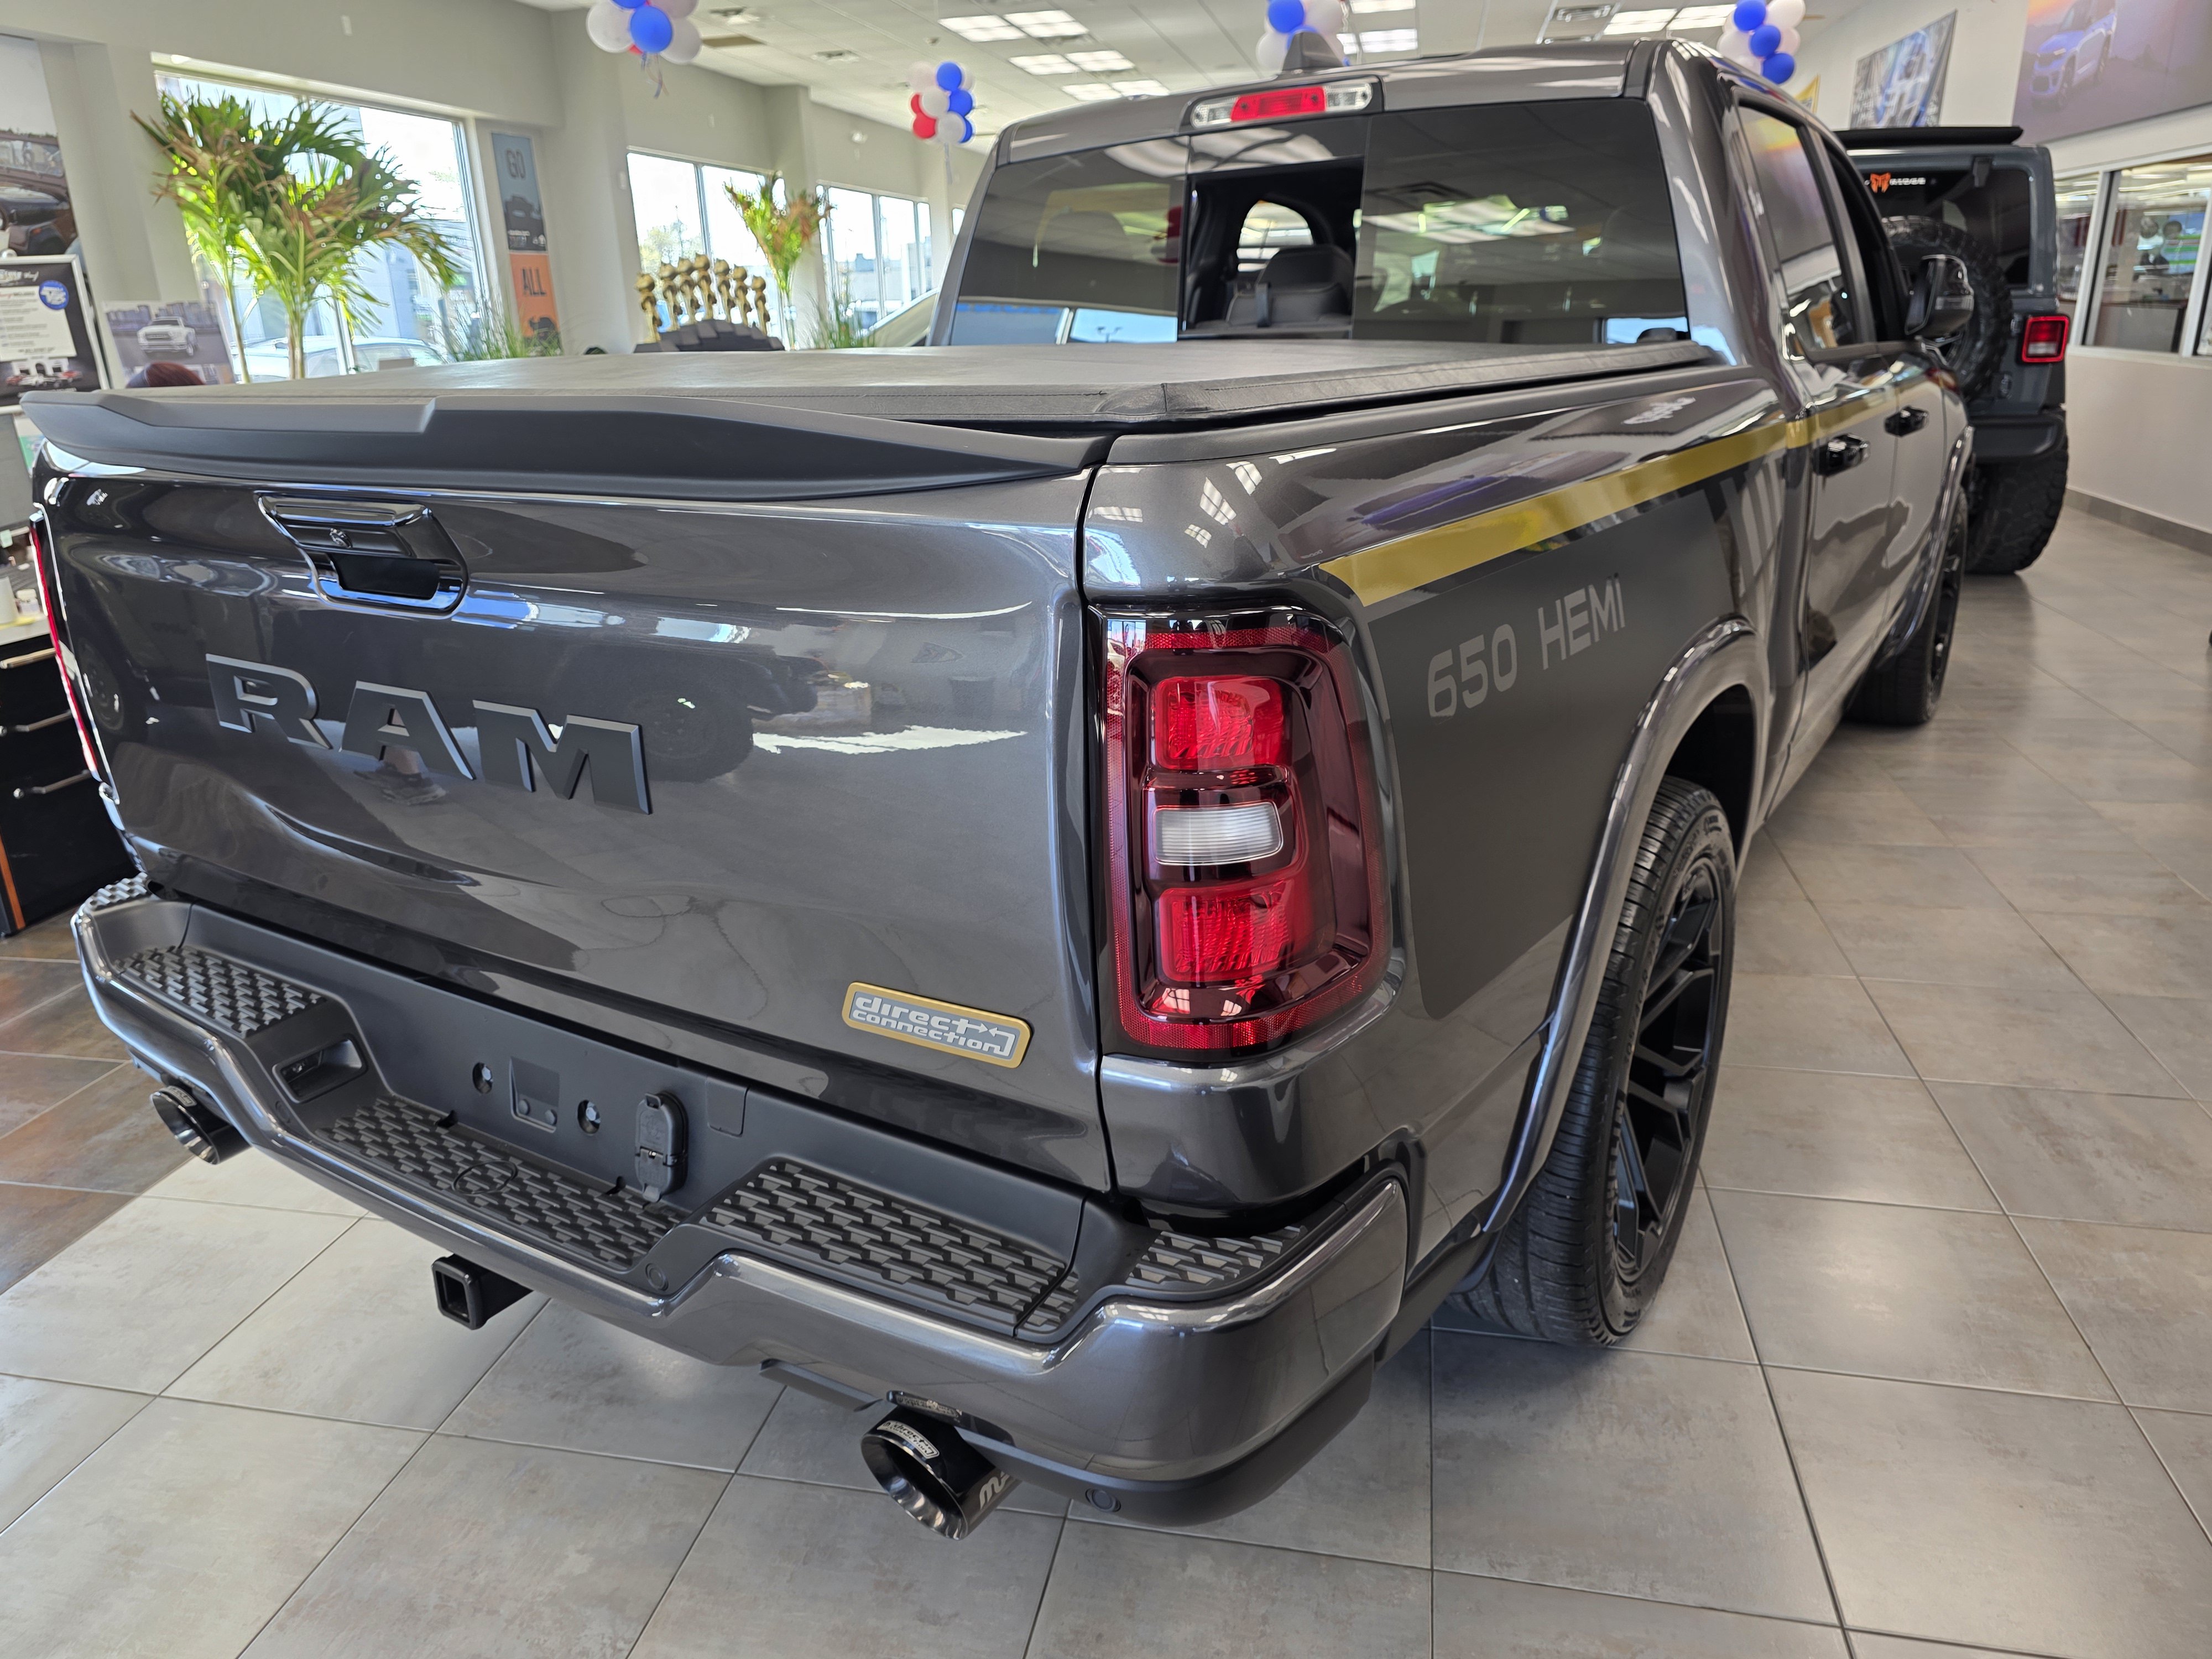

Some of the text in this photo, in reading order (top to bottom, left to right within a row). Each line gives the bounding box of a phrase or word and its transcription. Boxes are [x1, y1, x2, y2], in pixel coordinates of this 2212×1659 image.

[505, 150, 526, 179] GO
[522, 268, 546, 296] ALL
[1427, 572, 1626, 725] 650 HEMI
[205, 653, 654, 815] RAM
[852, 1009, 1009, 1057] connection
[855, 996, 972, 1035] direct
